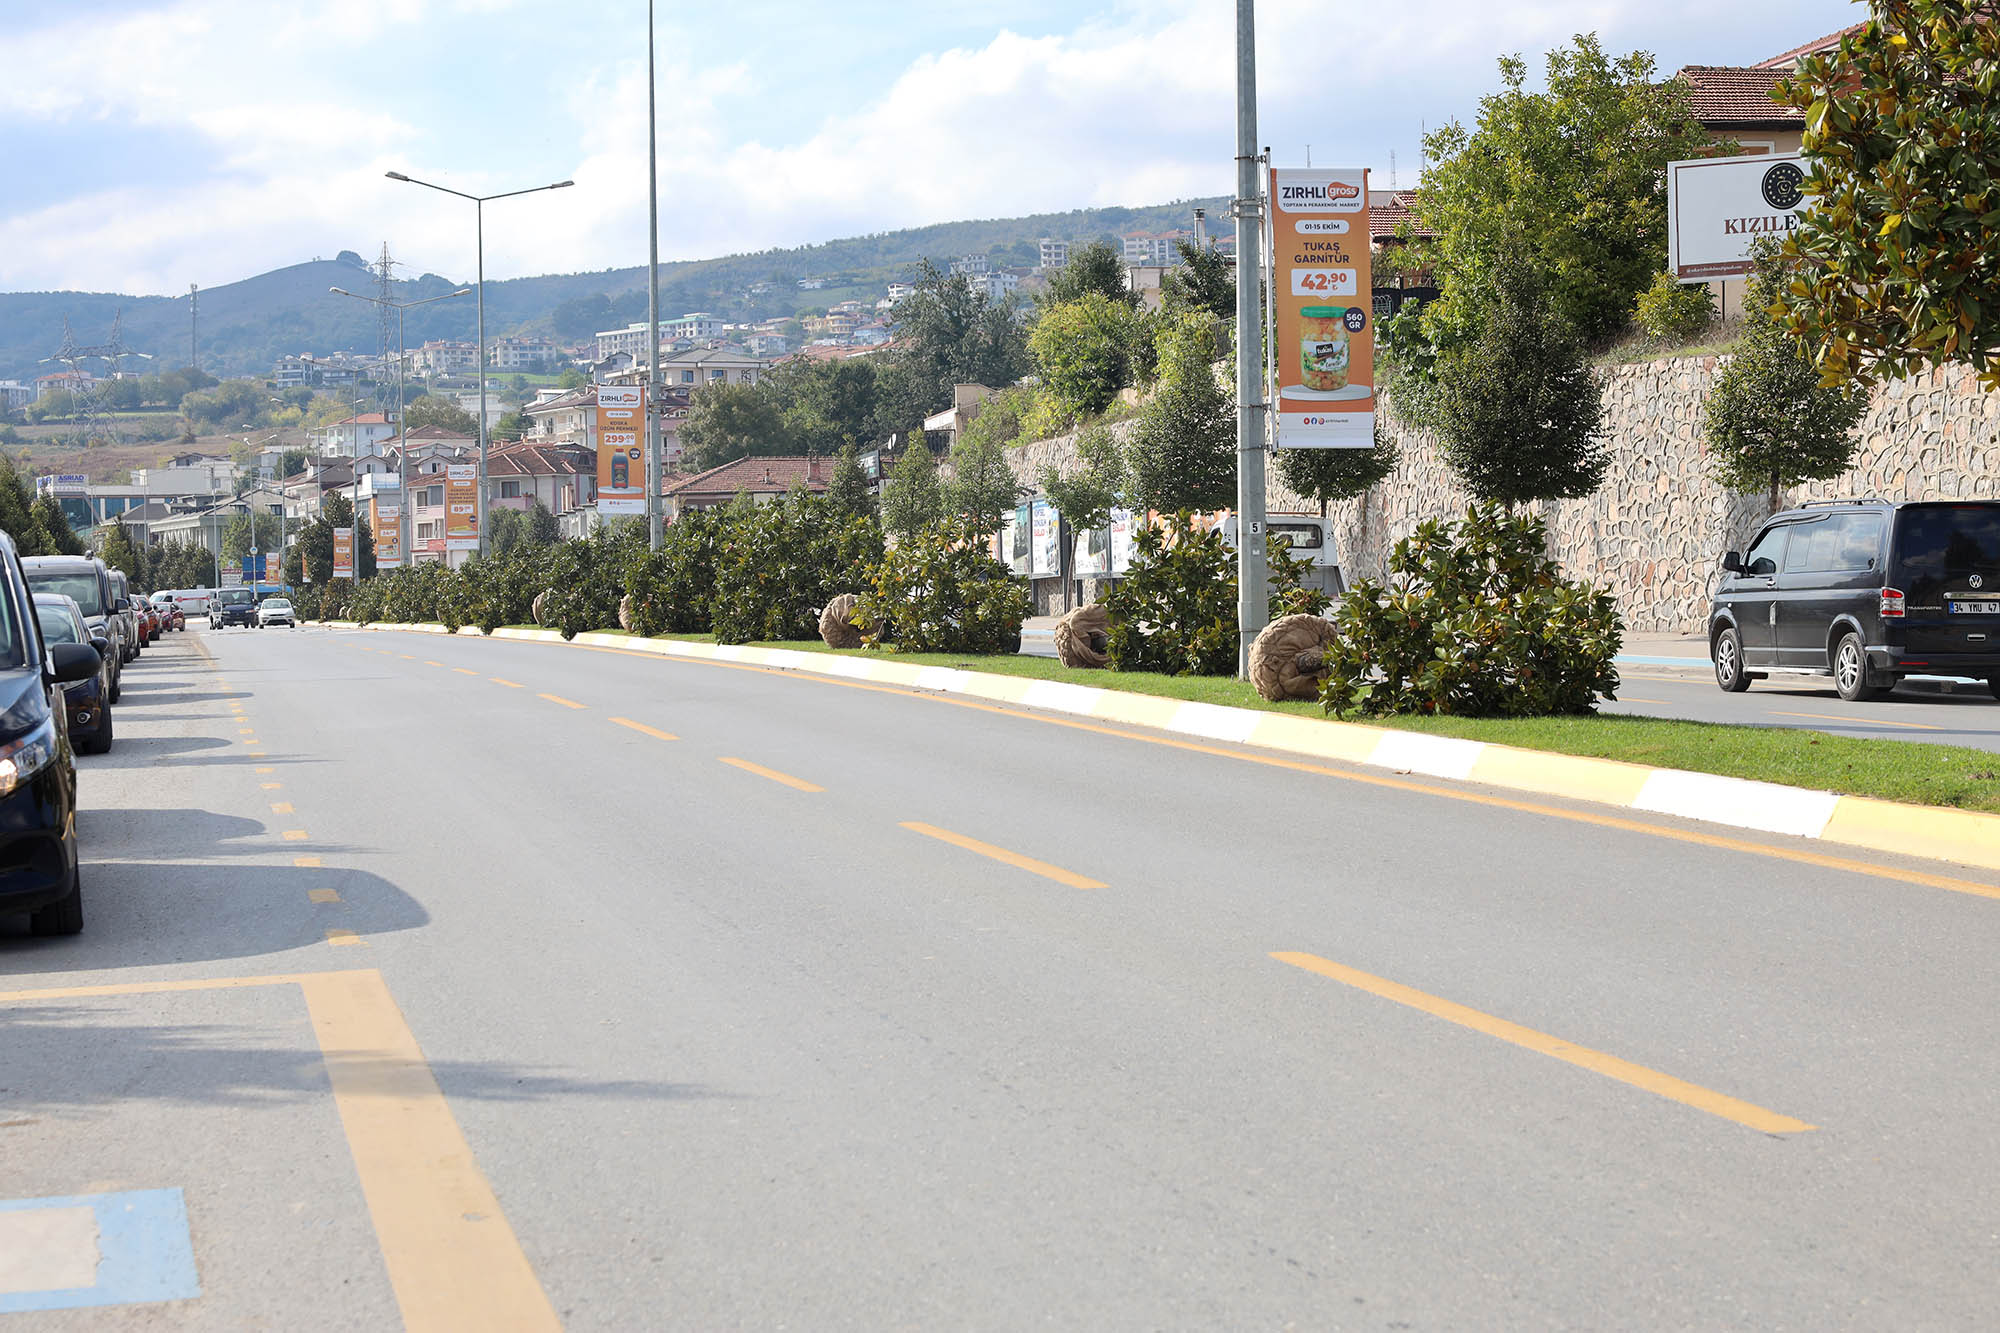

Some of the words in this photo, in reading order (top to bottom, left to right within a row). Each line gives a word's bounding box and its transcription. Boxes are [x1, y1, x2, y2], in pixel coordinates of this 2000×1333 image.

[1282, 187, 1326, 199] ZIRHLI
[1328, 187, 1357, 198] gross
[1322, 222, 1340, 230] EKİM
[1724, 214, 1803, 235] KIZILE
[1303, 242, 1340, 254] TUKAŞ
[1294, 252, 1350, 264] GARNİTÜR
[1346, 313, 1363, 321] 560
[1348, 321, 1361, 329] GR
[1252, 522, 1258, 533] 5
[1954, 603, 1963, 612] 34
[1968, 603, 1983, 612] YMU
